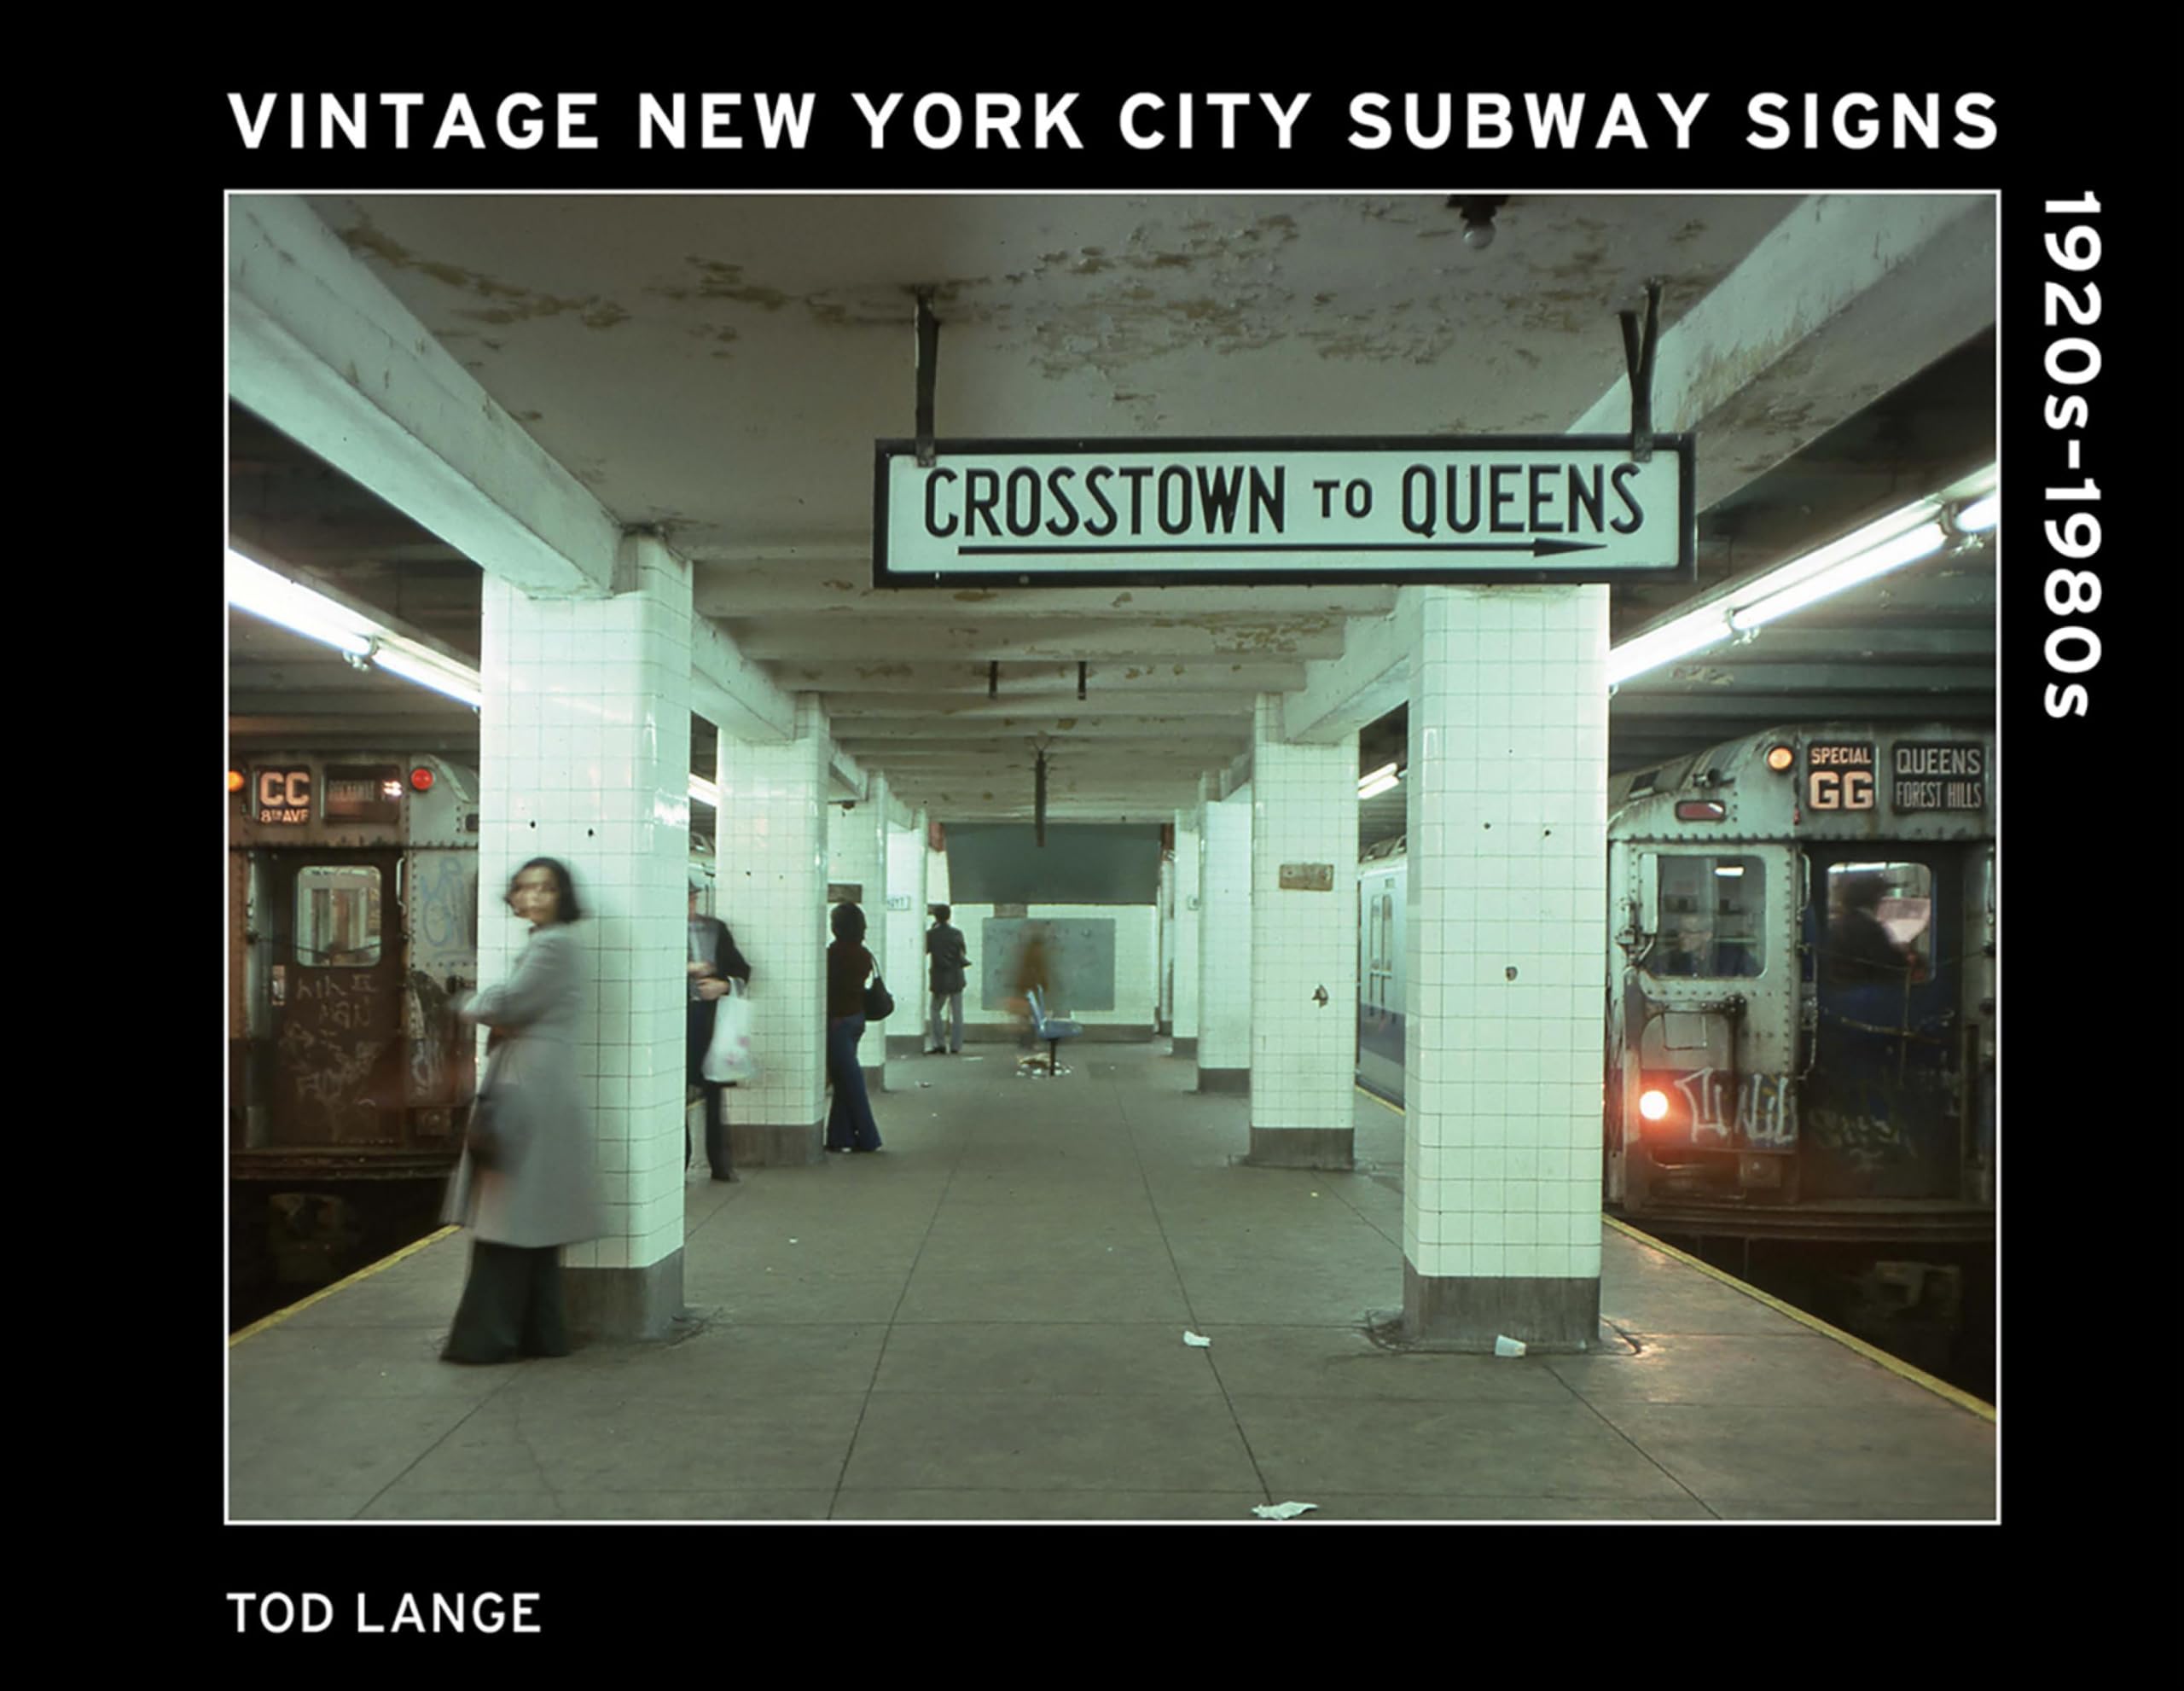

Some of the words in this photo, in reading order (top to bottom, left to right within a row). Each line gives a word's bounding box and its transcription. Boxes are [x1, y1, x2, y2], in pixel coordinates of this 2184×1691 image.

[924, 466, 1285, 537] CROSSTOWN
[1314, 479, 1372, 519] TO
[1401, 462, 1645, 538] QUEENS
[1810, 747, 1872, 764] SPECIAL
[1896, 747, 1981, 774] QUEENS
[260, 771, 310, 806] CC
[1809, 770, 1873, 809] GG
[1896, 782, 1943, 808] FOREST
[1947, 782, 1982, 808] HILLS
